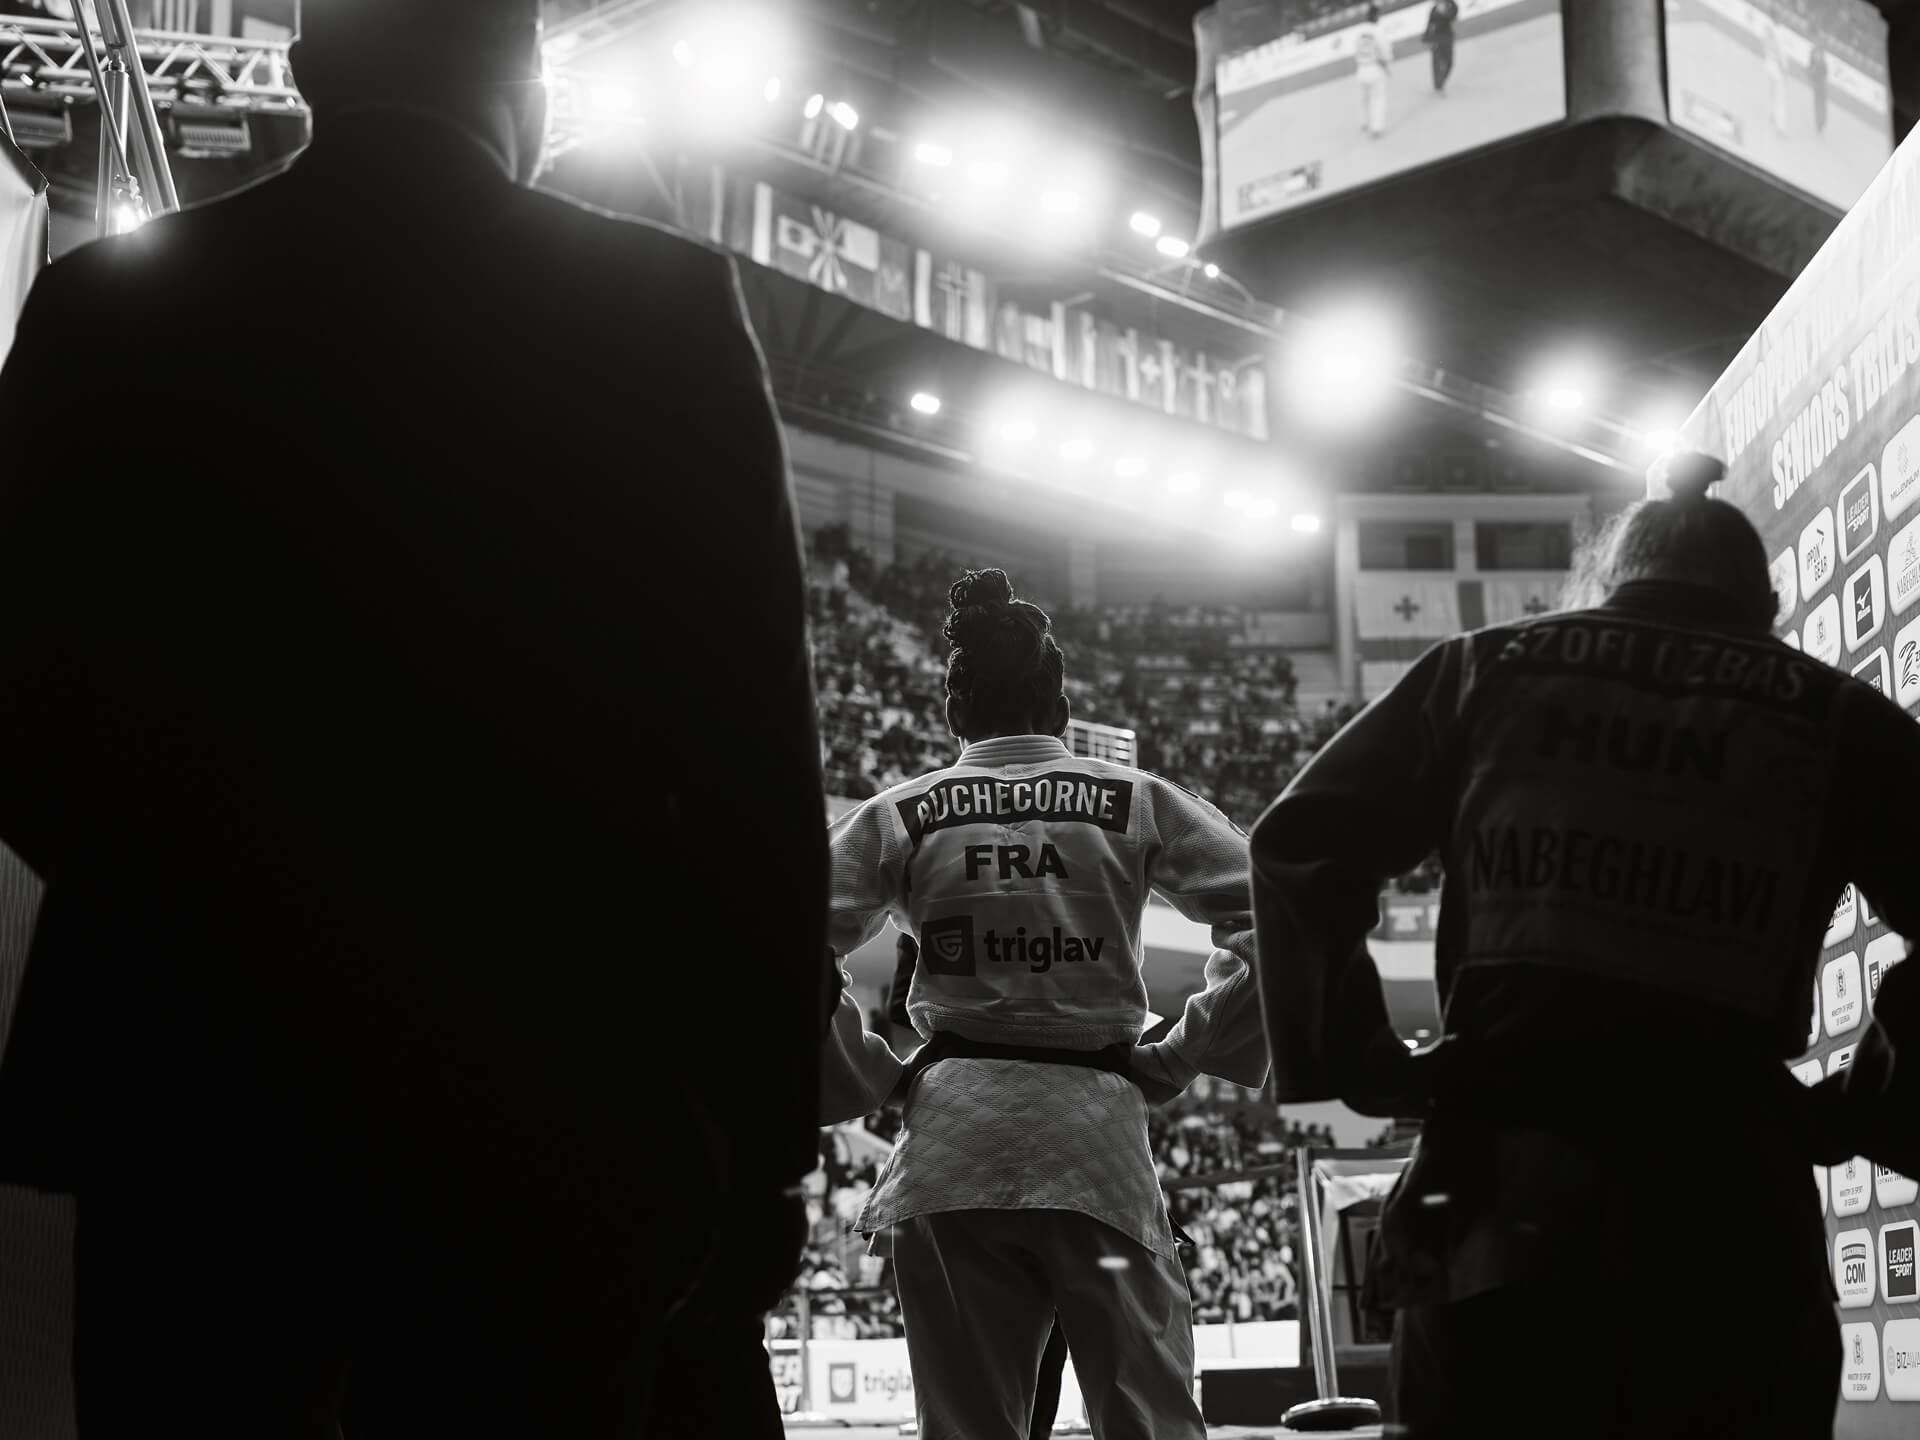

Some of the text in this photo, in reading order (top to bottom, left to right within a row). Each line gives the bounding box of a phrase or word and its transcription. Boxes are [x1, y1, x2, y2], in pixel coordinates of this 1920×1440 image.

[1772, 365, 1850, 511] SENIORS
[1850, 272, 1920, 422] TBILIS
[1846, 491, 1869, 523] LEADER
[1850, 506, 1870, 532] SPORT
[1498, 626, 1636, 670] SZOFI
[1537, 704, 1730, 784] HUN
[917, 778, 1118, 827] AUCHECORNE
[965, 842, 1069, 881] FRA
[1472, 827, 1780, 935] NABEGHLAVI
[983, 926, 1105, 974] triglav
[1843, 1262, 1866, 1285] .COM
[1888, 1247, 1913, 1264] LEADER
[1893, 1262, 1913, 1277] SPORT
[863, 1368, 914, 1402] trigla
